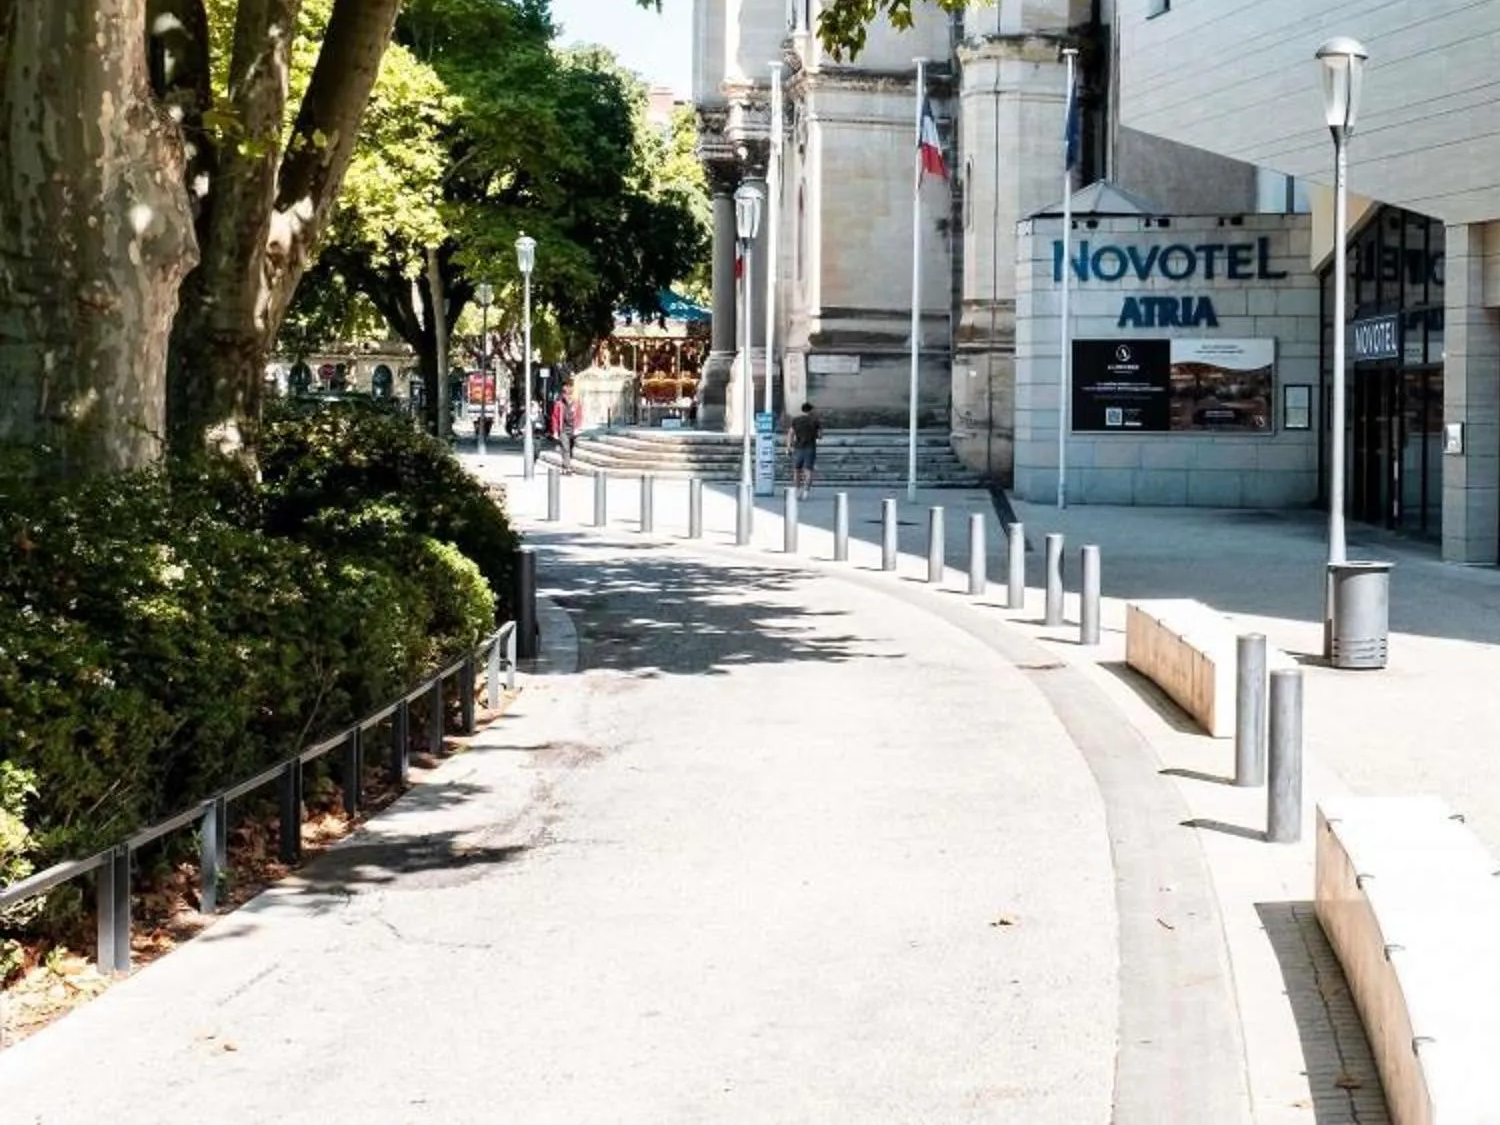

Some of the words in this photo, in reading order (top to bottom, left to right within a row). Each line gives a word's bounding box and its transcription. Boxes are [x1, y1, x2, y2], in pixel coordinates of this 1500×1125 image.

[1053, 236, 1288, 282] NOVOTEL
[1117, 296, 1219, 328] ATRIA
[1355, 322, 1397, 354] NOVOTEL
